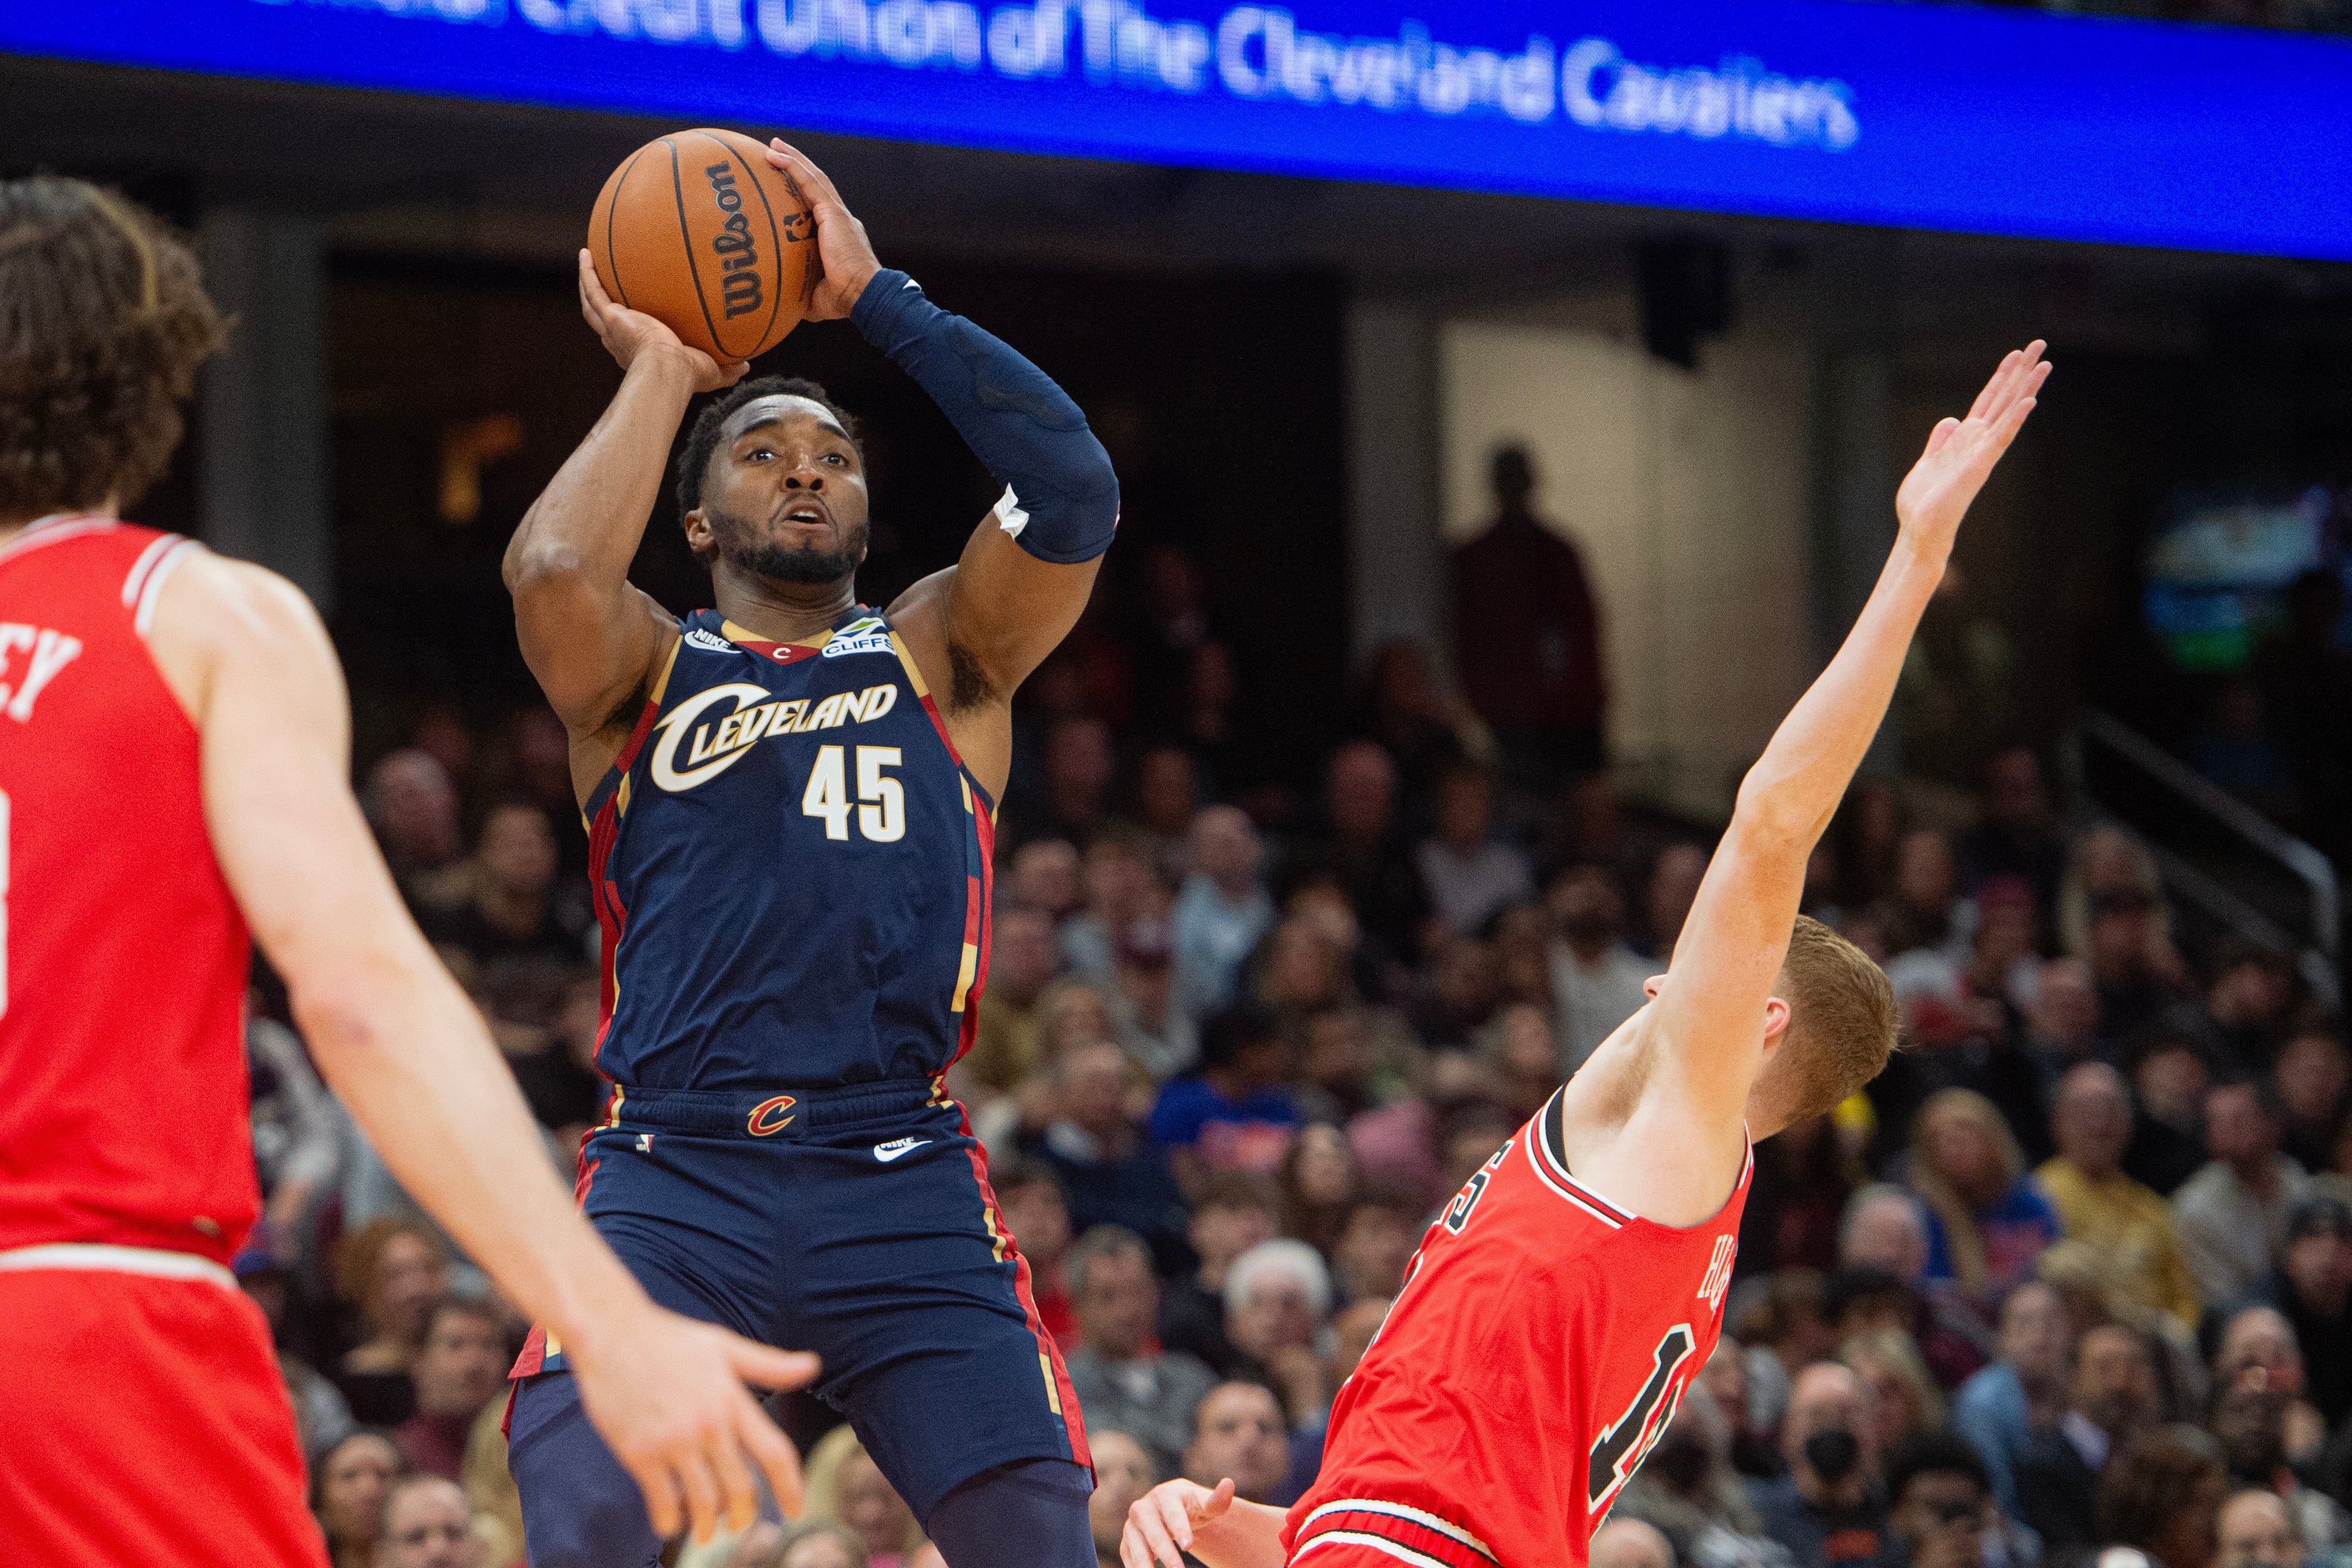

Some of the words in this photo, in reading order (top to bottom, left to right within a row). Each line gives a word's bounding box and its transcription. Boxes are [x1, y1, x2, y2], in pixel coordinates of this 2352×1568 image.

[752, 0, 984, 74] Union
[986, 0, 1064, 79] of
[1064, 0, 1209, 94] The
[1215, 5, 1557, 122] Cleveland
[1561, 34, 1860, 152] Cavaliers
[705, 161, 762, 321] Wilson
[694, 628, 731, 649] NIKE
[825, 637, 894, 655] CLIFFS
[651, 682, 898, 792] CLEVELAND
[802, 744, 906, 843] 45
[878, 1136, 915, 1149] NIKE
